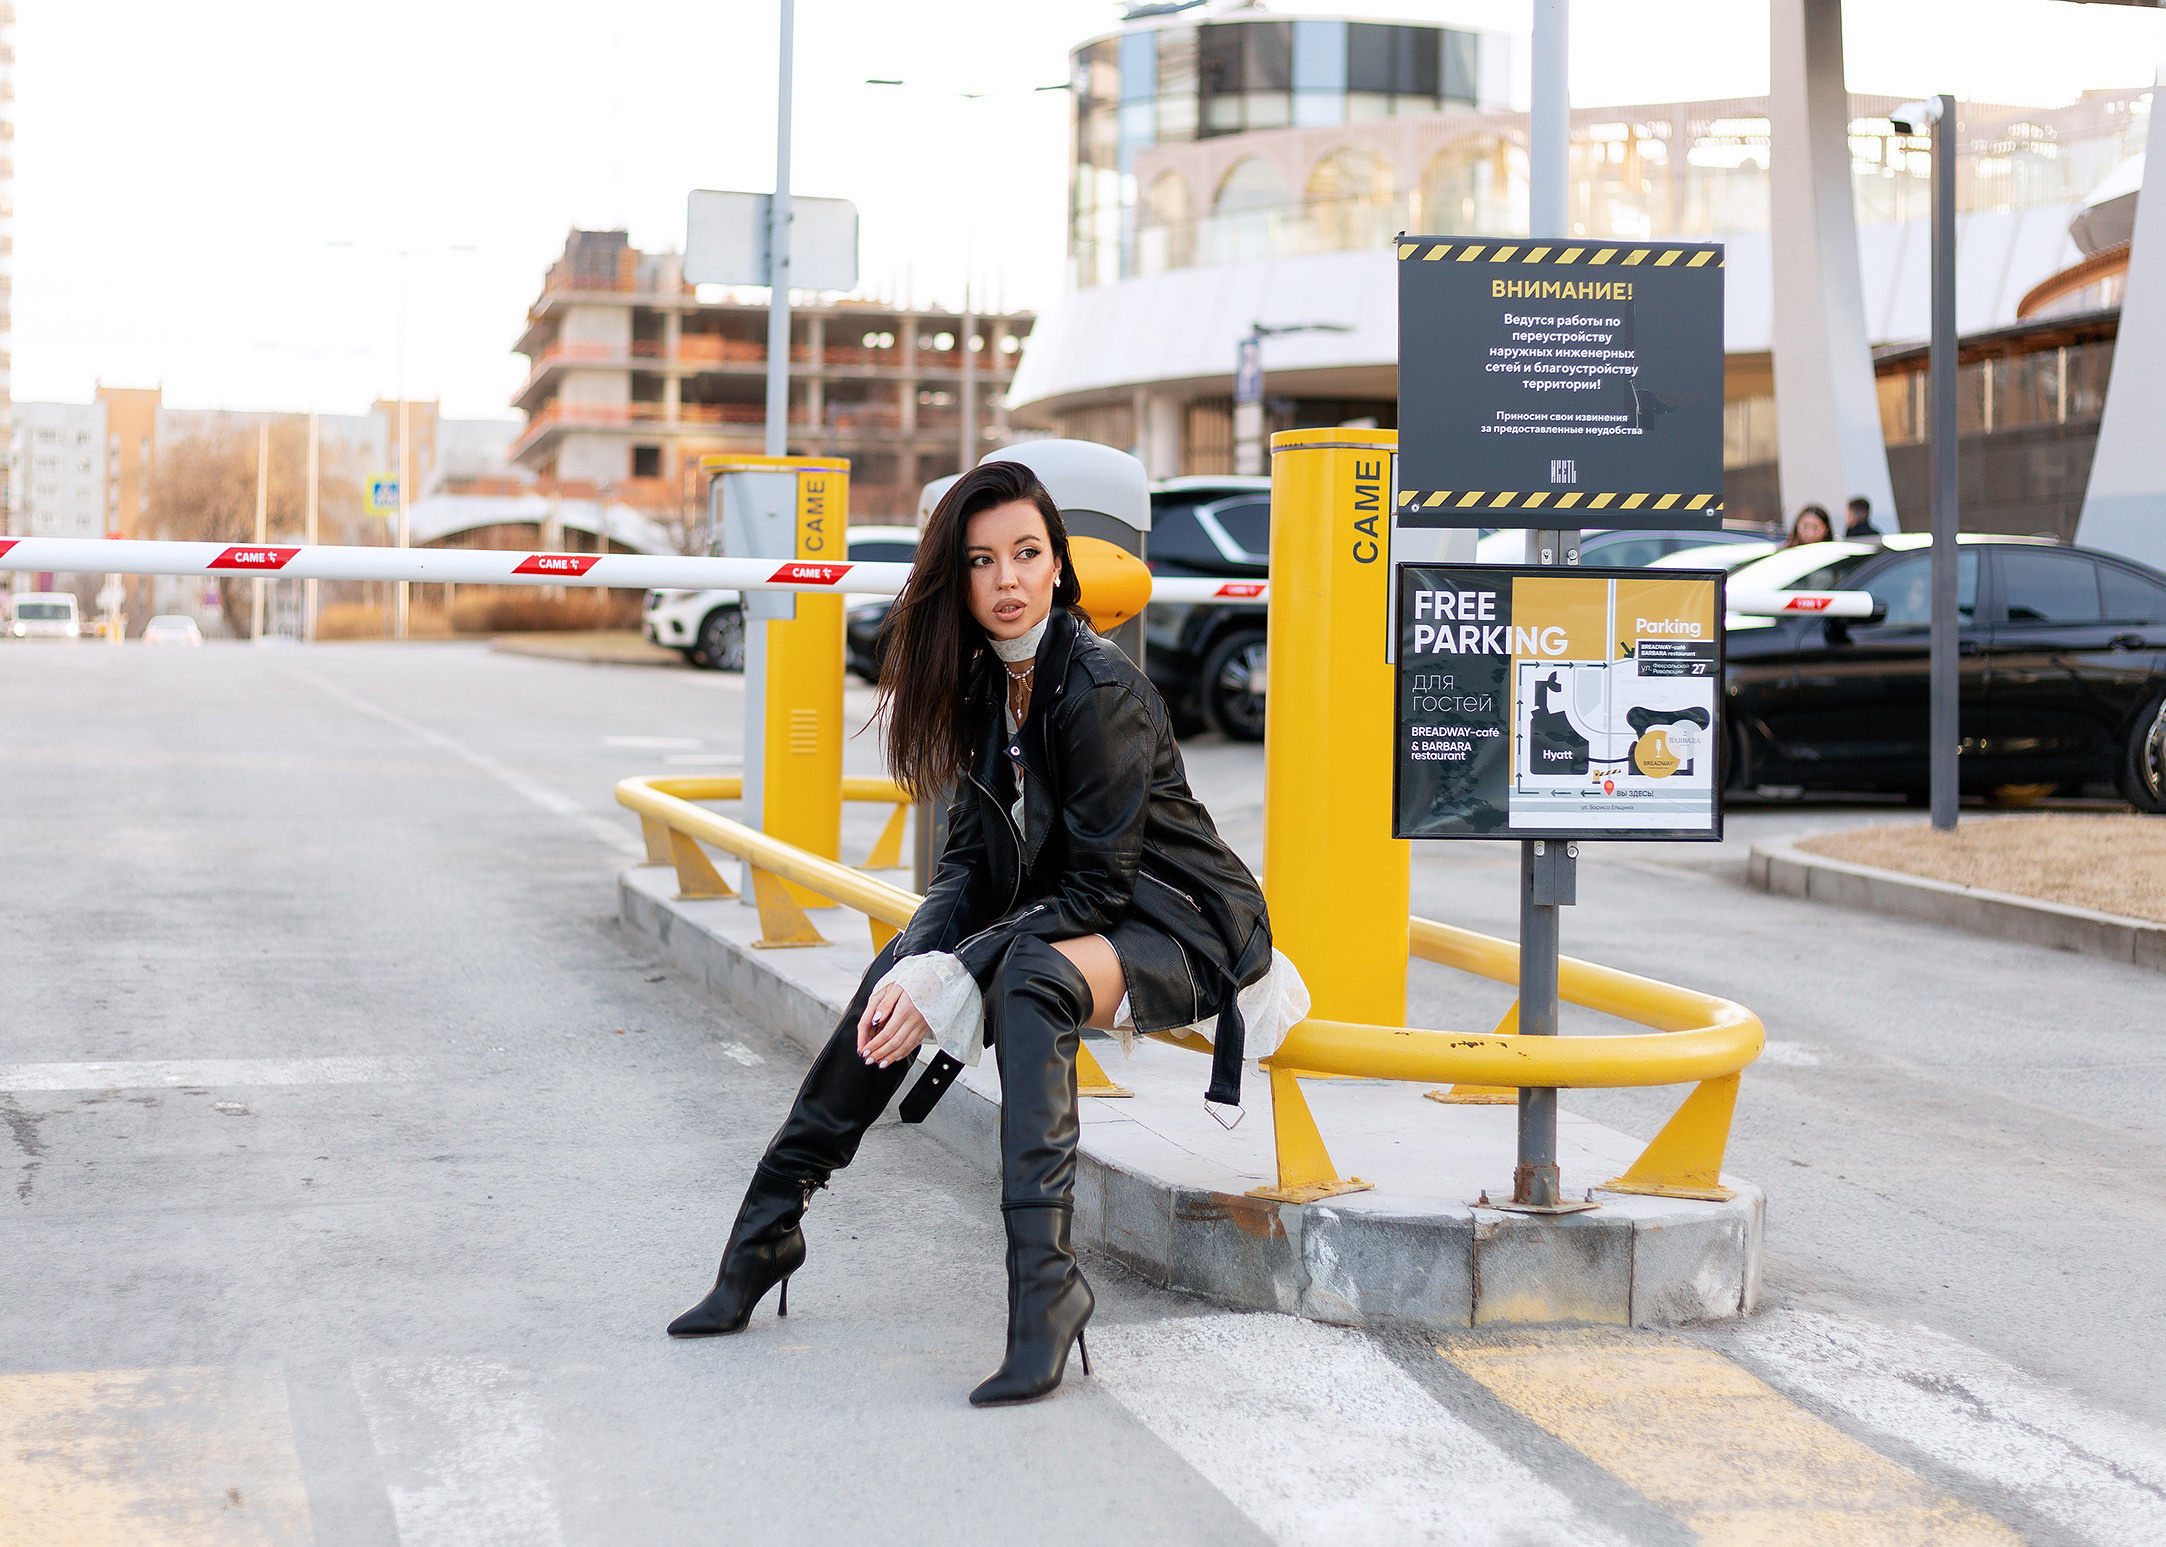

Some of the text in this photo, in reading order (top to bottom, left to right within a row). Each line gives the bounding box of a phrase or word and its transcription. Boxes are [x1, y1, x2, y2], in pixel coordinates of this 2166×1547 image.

[1492, 280, 1633, 300] ВНИМАНИЕ!
[1504, 314, 1621, 328] Ведутся работы по
[1512, 331, 1612, 345] переустройству
[1489, 347, 1635, 360] наружных инженерных
[1485, 362, 1639, 377] сетей и благоустройству
[1522, 379, 1601, 392] территории!
[1496, 411, 1628, 422] Приносим свои извинения
[1480, 425, 1643, 437] за предоставленные неудобства
[805, 480, 825, 551] CAME
[1353, 461, 1381, 564] CAME
[235, 552, 265, 563] CAME
[539, 559, 567, 569] CAME
[792, 567, 821, 578] CAME
[1415, 590, 1496, 621] FREE
[1636, 617, 1701, 638] Parking
[1414, 624, 1568, 656] PARKING
[1641, 665, 1652, 673] ул.
[1691, 664, 1706, 674] 27
[1412, 674, 1454, 693] для
[1413, 693, 1492, 712] гостей
[1411, 727, 1499, 738] BREADWAY-café
[1411, 741, 1472, 751] & BARBARA
[1411, 751, 1466, 761] restaurant
[1543, 749, 1573, 761] Hyatt
